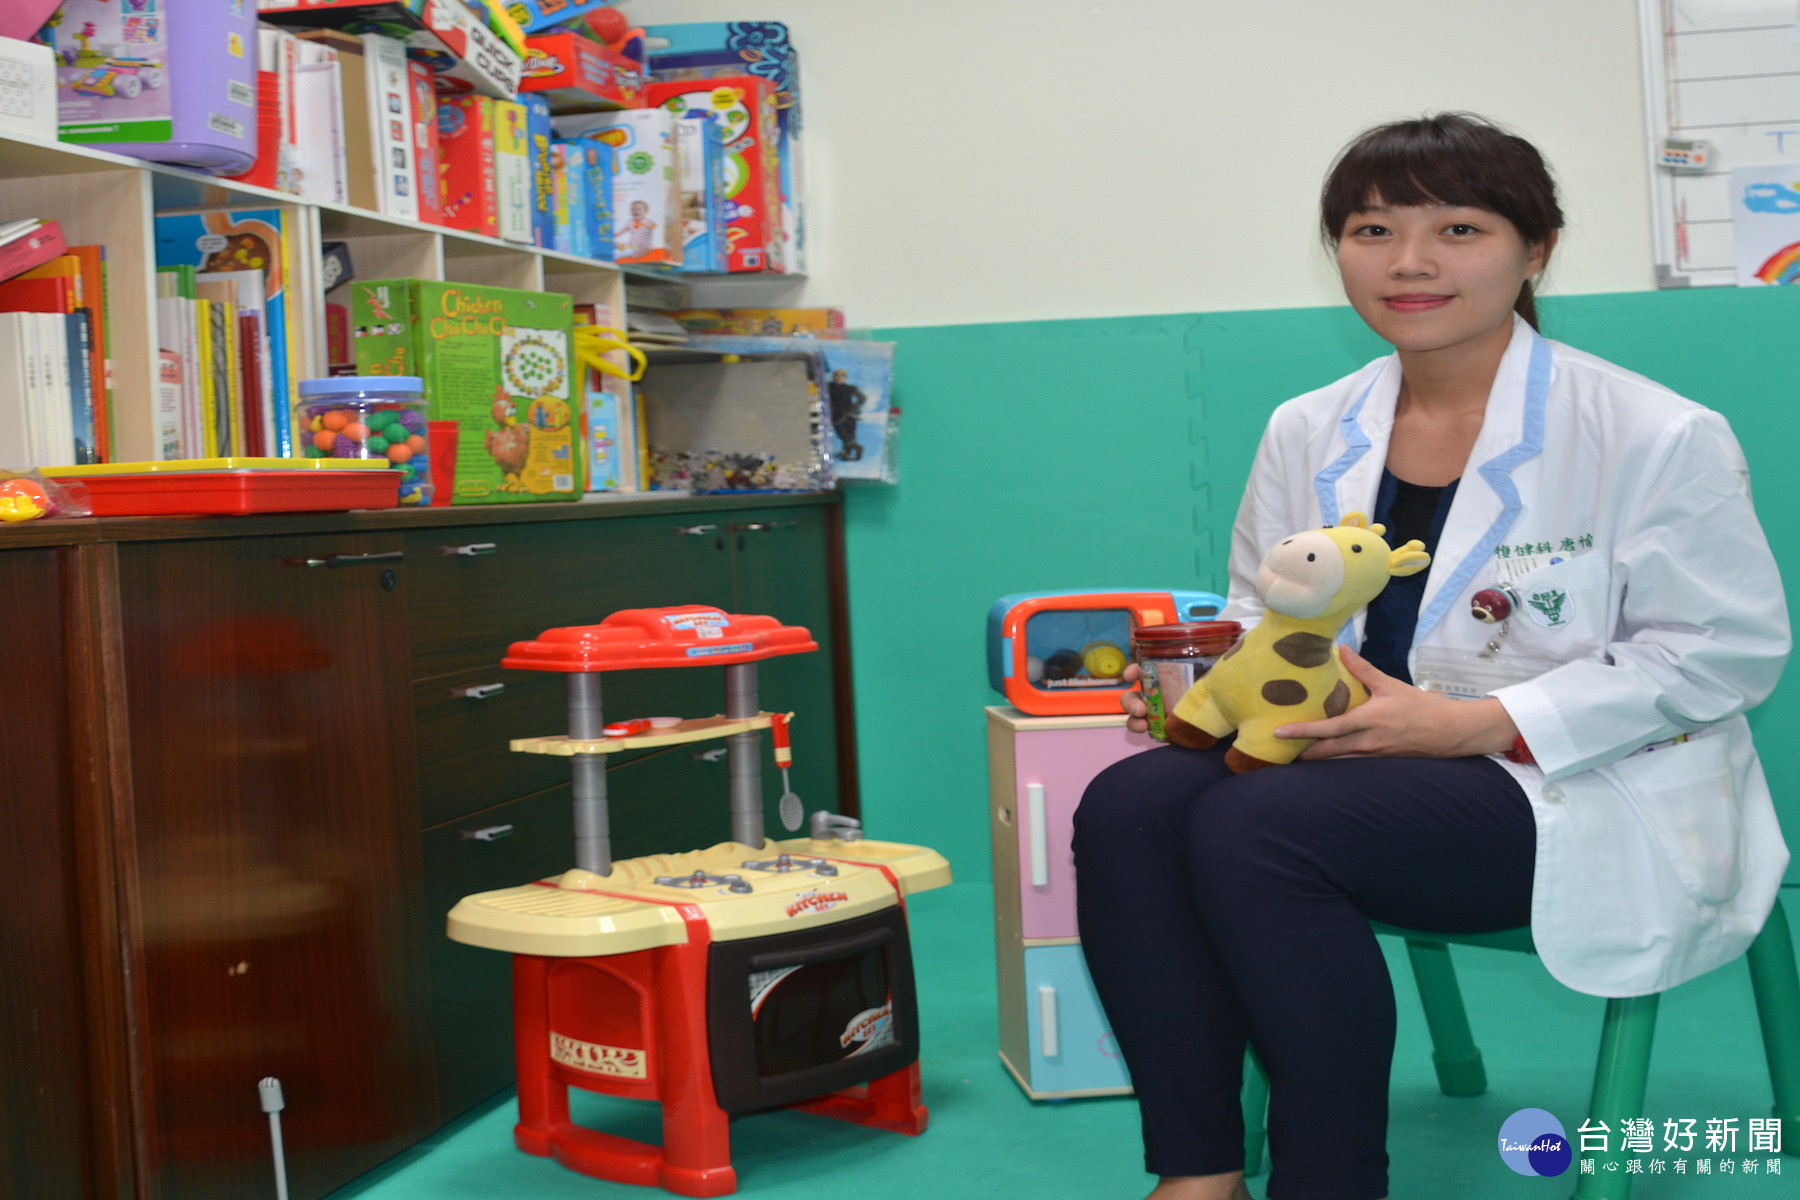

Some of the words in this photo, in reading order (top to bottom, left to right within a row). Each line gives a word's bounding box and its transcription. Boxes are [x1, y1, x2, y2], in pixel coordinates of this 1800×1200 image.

[470, 27, 515, 71] QUICK
[475, 52, 516, 95] CUPS
[441, 289, 503, 318] Chicken
[785, 892, 849, 918] KITCHEN
[815, 903, 829, 912] SET
